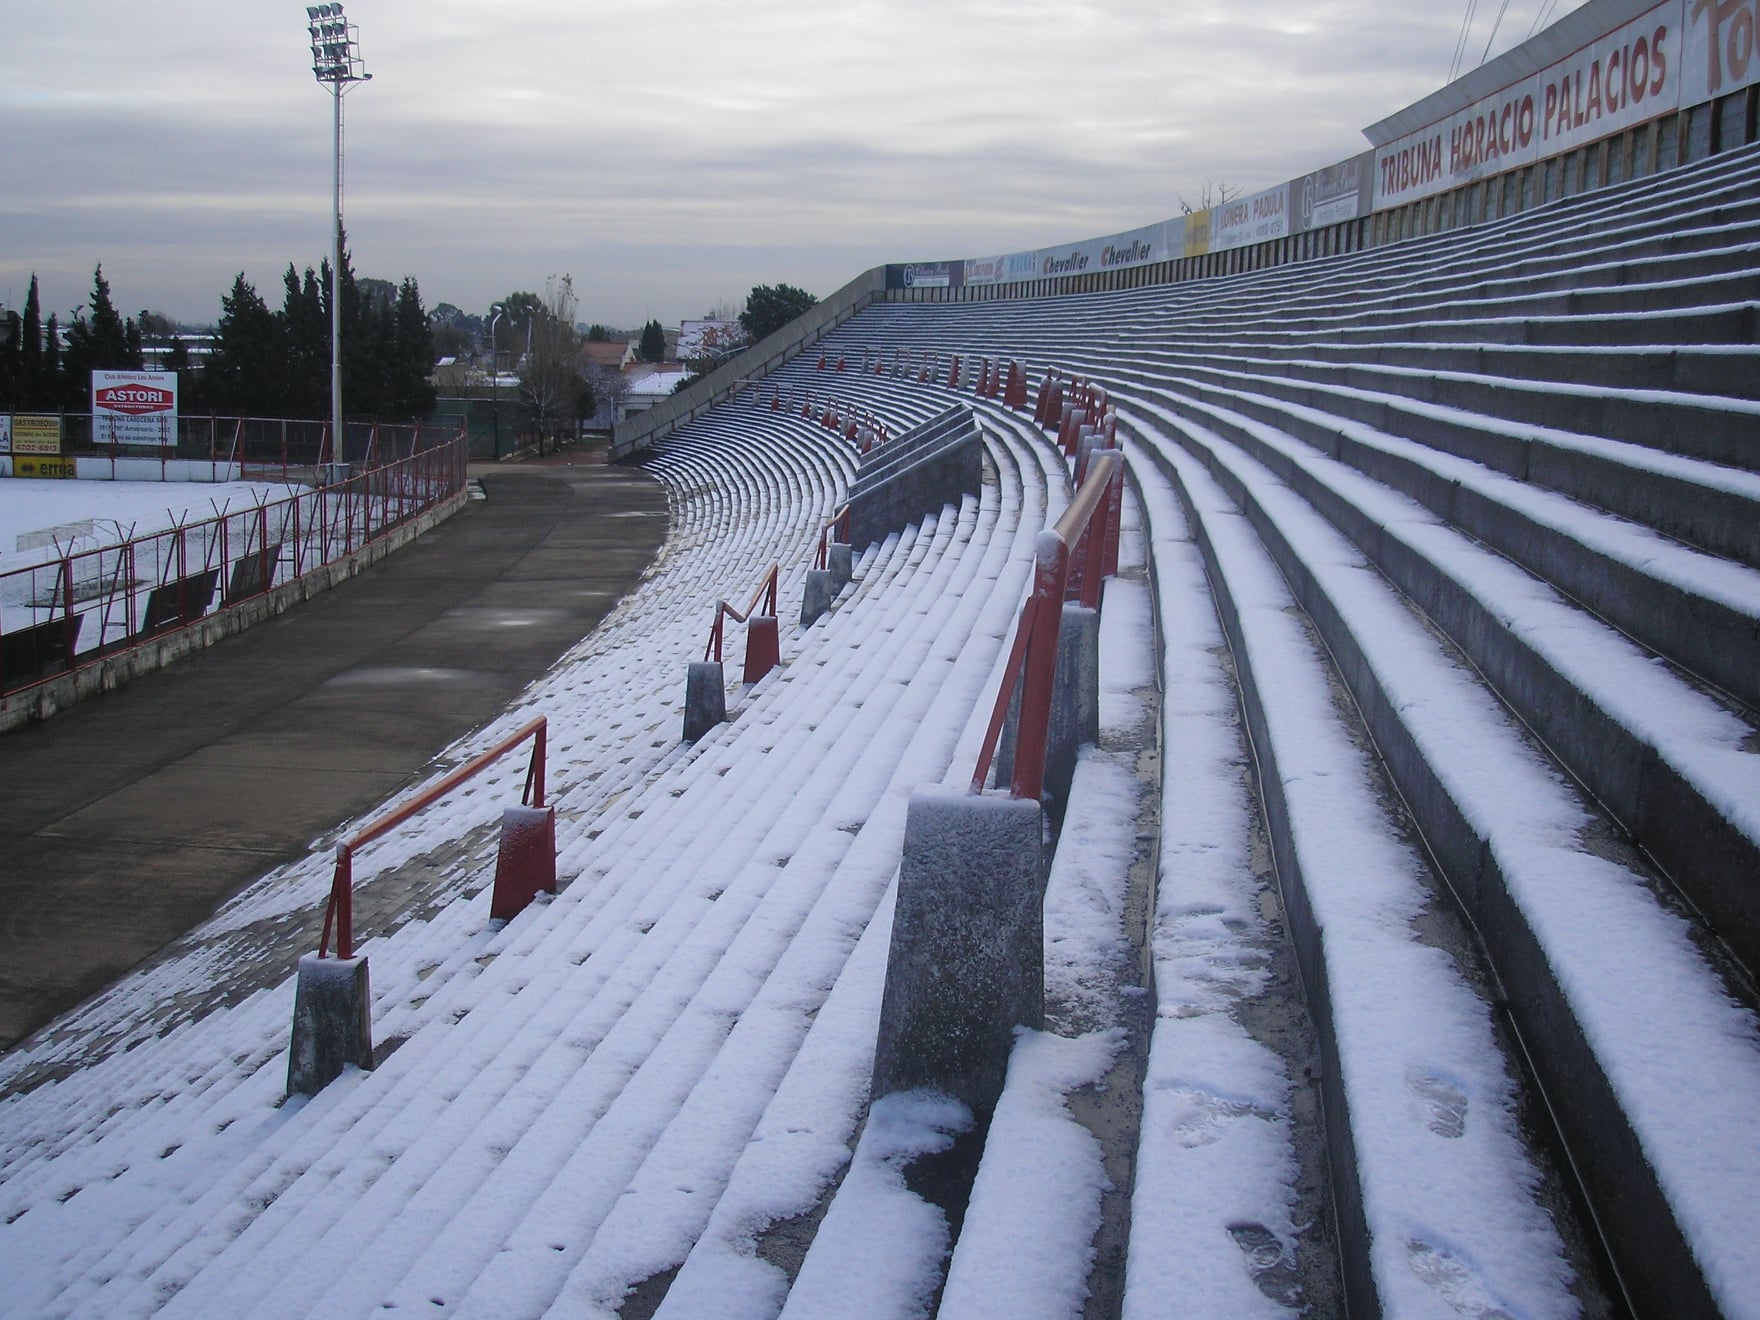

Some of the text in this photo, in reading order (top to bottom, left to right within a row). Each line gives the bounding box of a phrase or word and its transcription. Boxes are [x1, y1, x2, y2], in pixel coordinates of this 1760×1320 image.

[1691, 0, 1760, 96] To
[1380, 134, 1442, 198] TRIBUNA
[1449, 94, 1534, 175] HORACIO
[1542, 25, 1667, 140] PALACIOS
[1043, 251, 1089, 275] Chevallier
[1101, 239, 1152, 267] Chevallier
[105, 390, 163, 402] ASTORI
